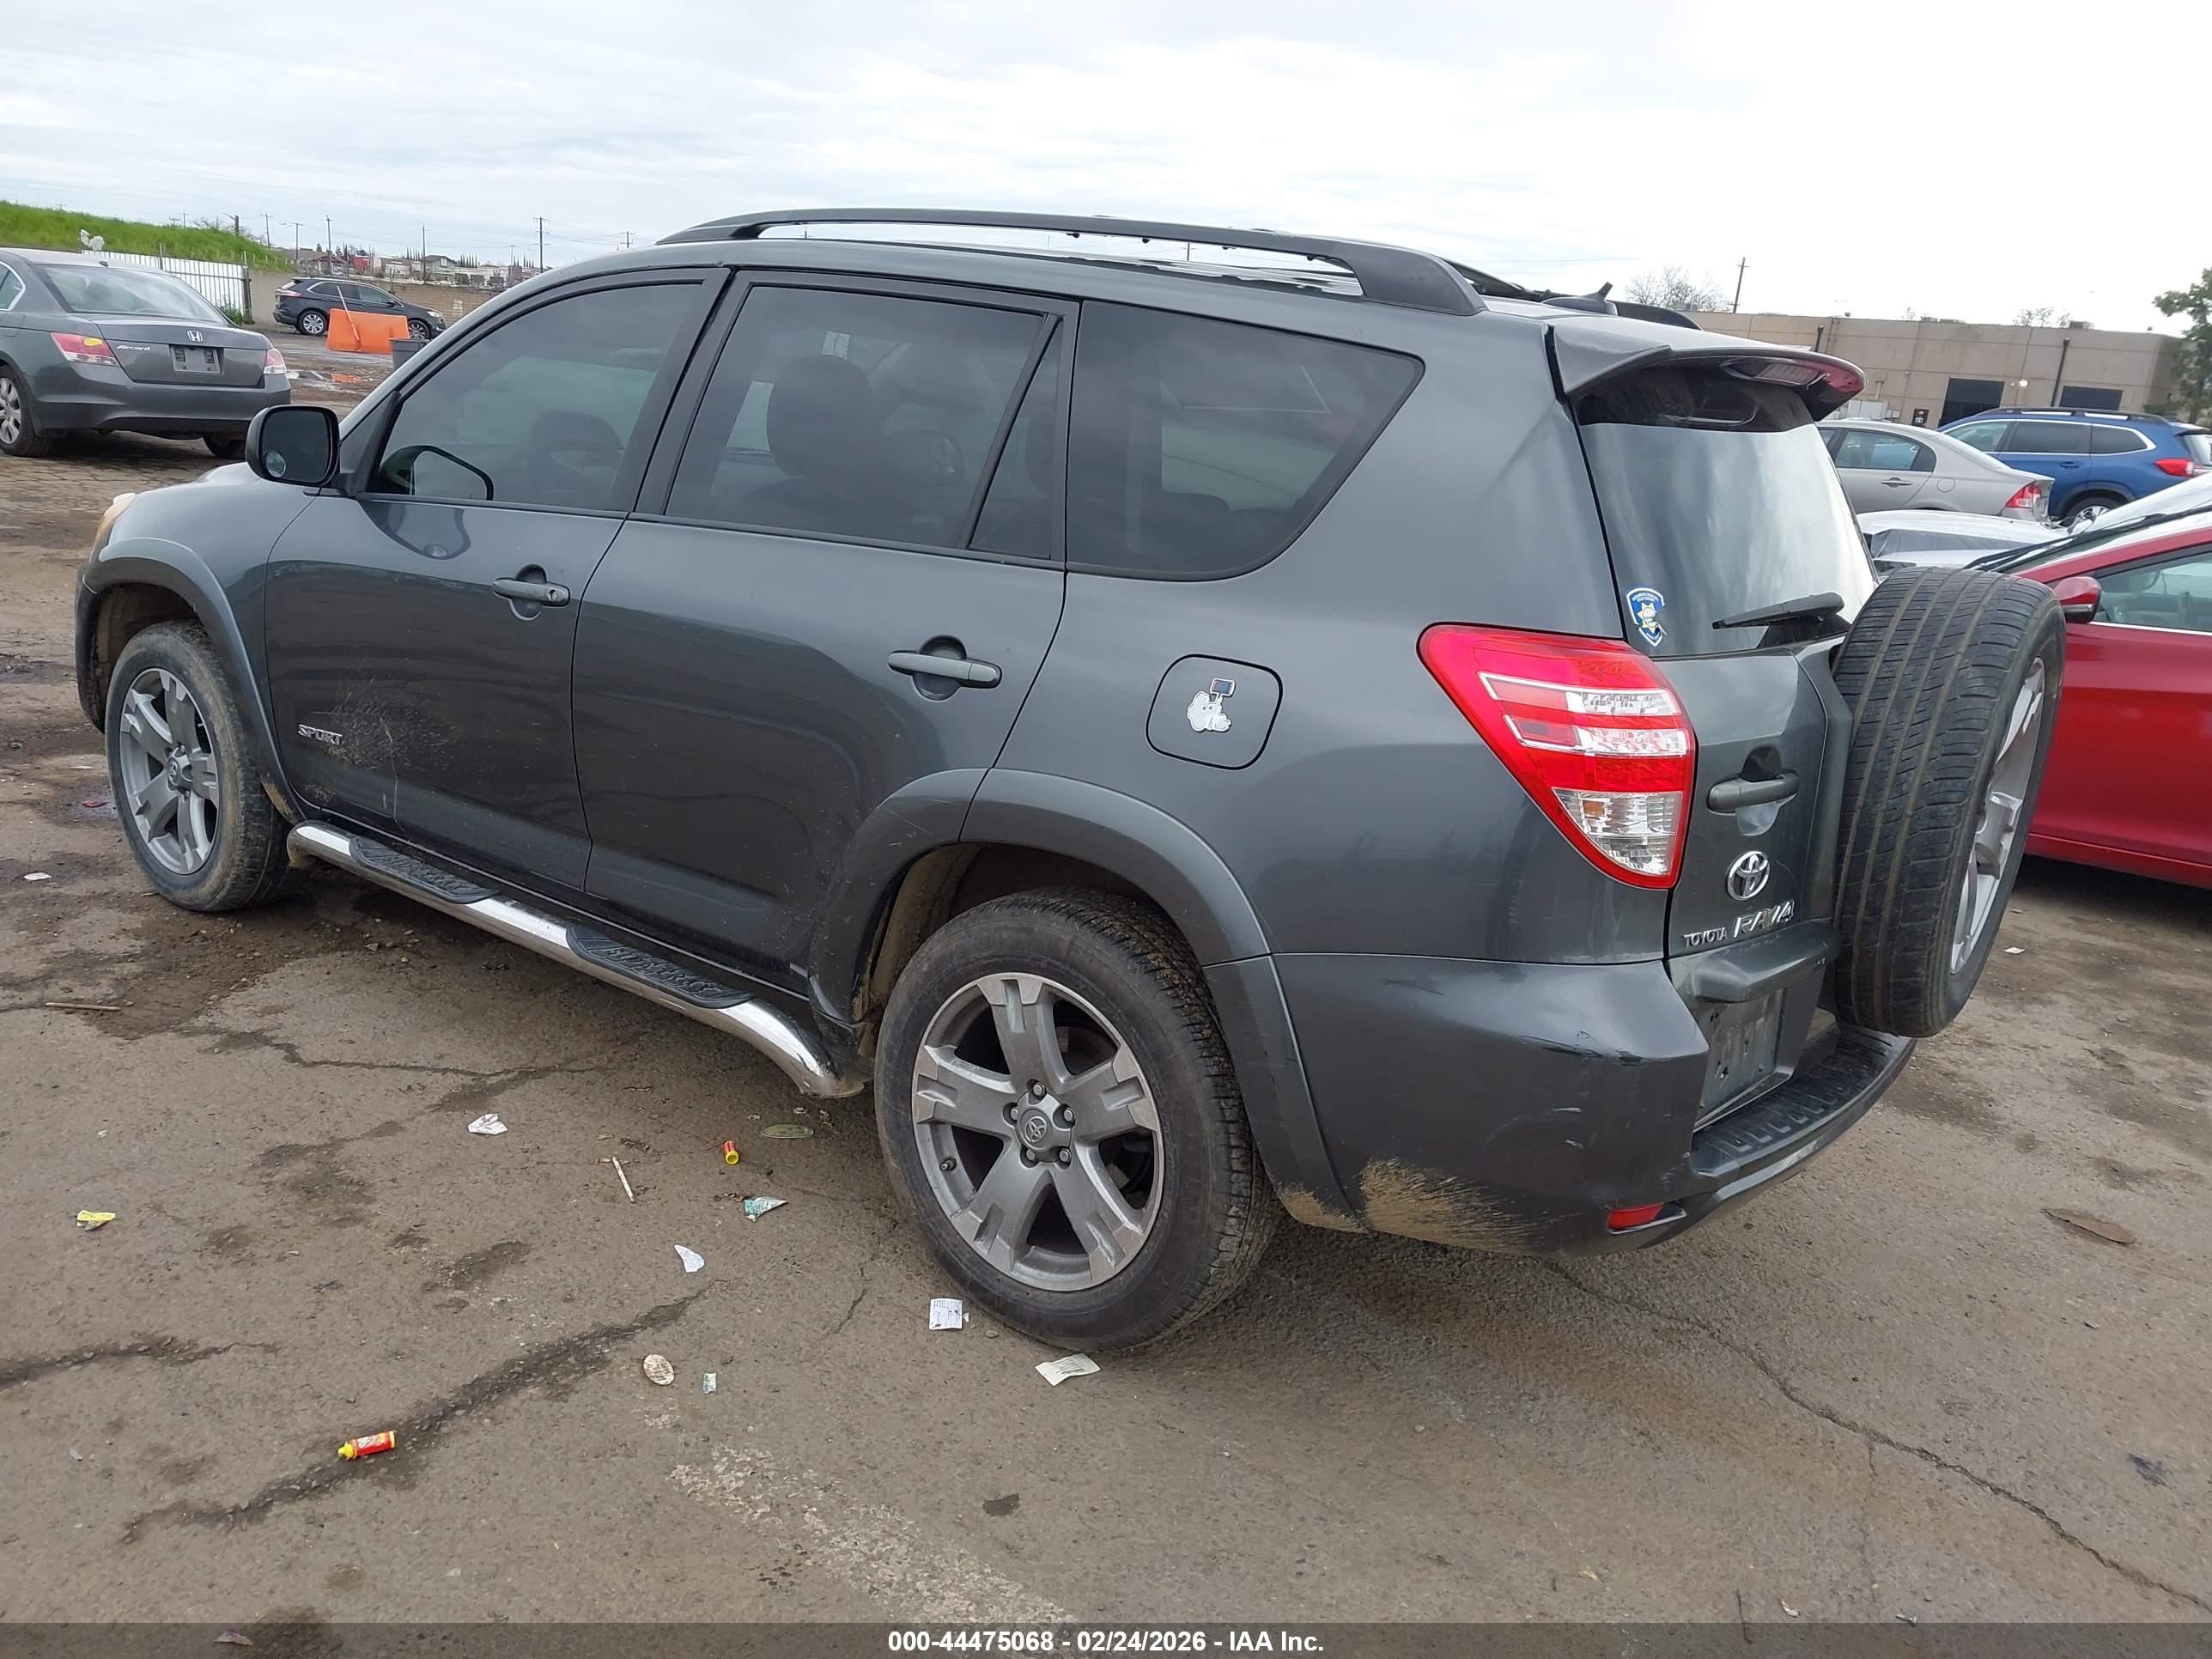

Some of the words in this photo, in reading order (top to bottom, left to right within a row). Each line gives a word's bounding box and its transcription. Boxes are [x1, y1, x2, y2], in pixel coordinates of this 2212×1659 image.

[297, 724, 343, 745] SPORT
[1683, 927, 1727, 947] TOYOTA
[1733, 899, 1795, 938] RAV4
